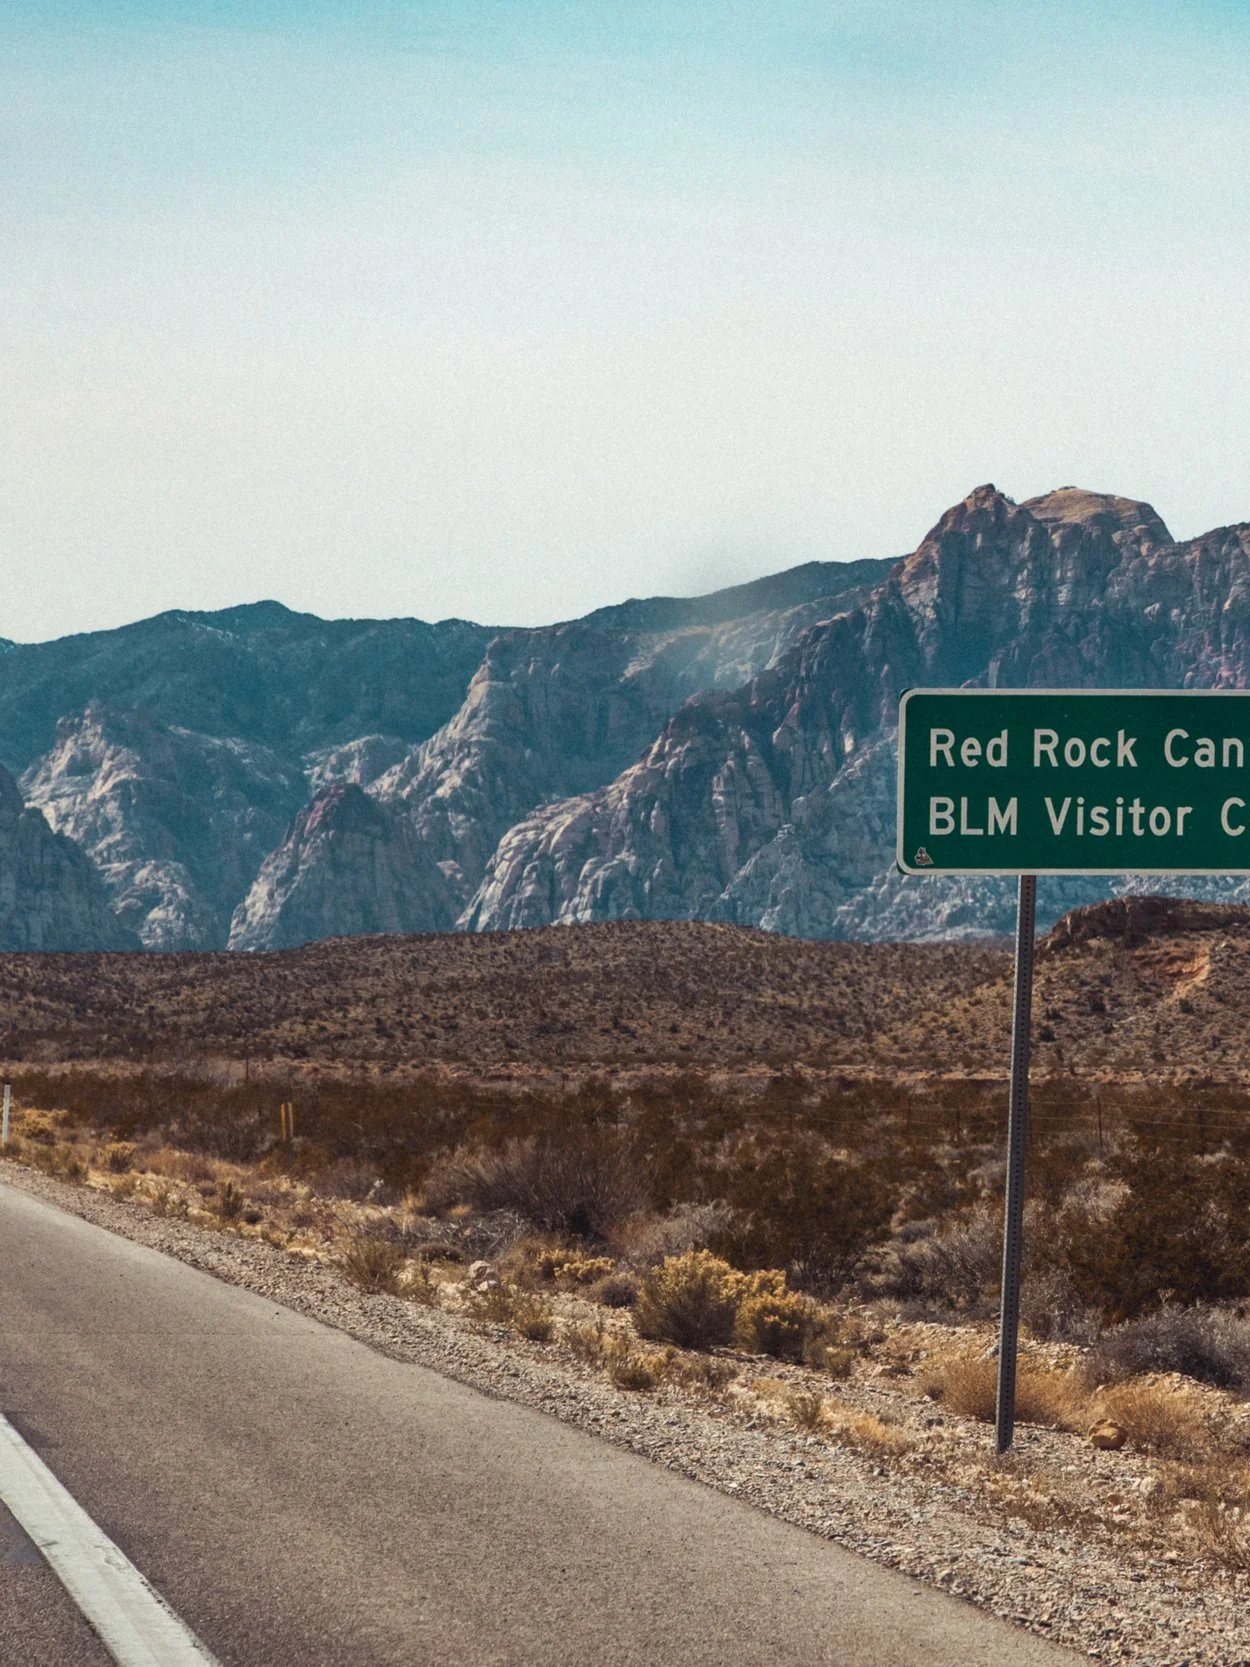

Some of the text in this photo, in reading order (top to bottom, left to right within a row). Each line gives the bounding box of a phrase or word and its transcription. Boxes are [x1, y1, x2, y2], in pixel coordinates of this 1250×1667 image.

[929, 728, 1008, 768] Red
[1033, 728, 1138, 768] Rock
[929, 796, 1018, 836] BLM
[1044, 796, 1193, 836] Visitor
